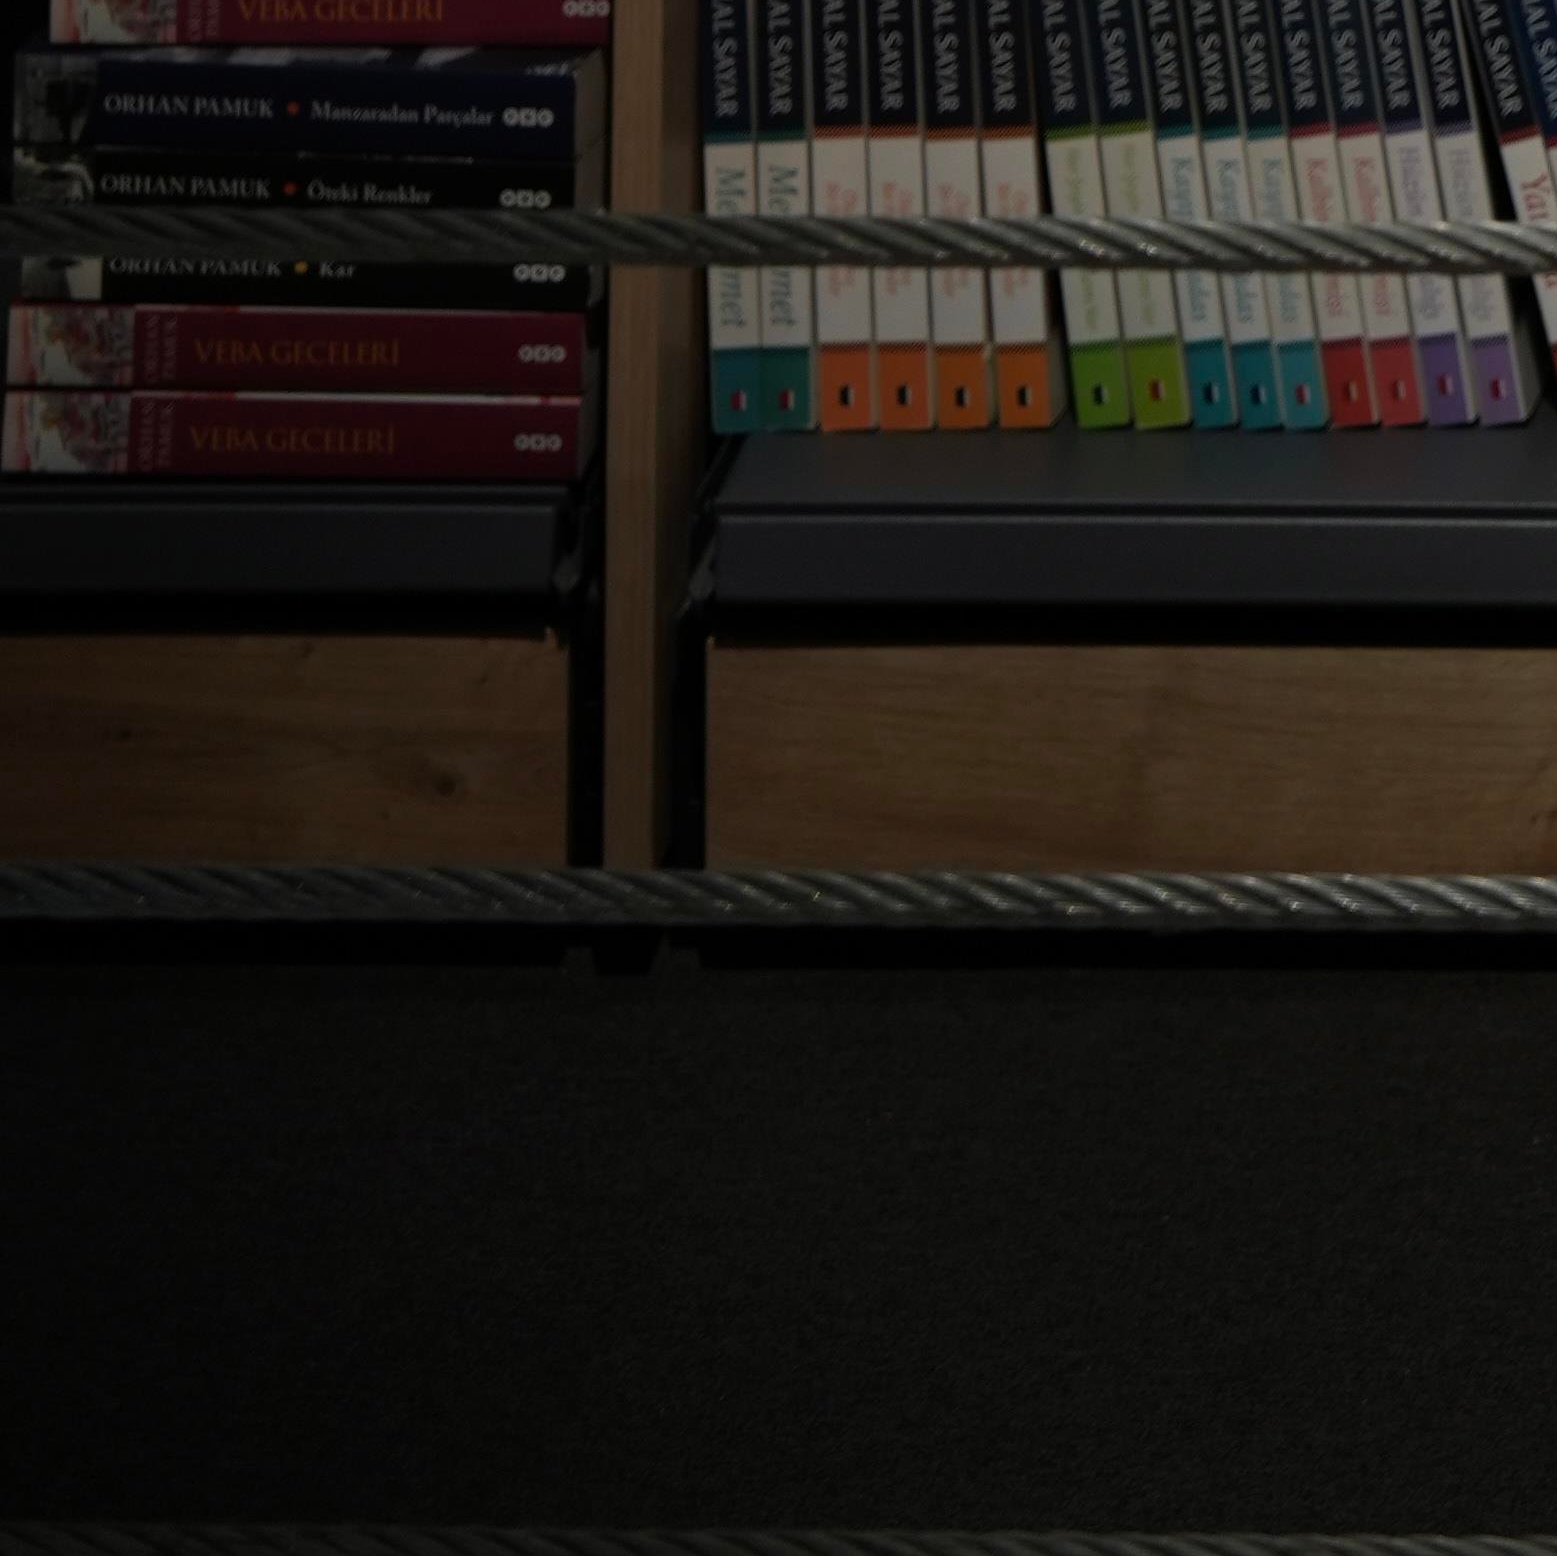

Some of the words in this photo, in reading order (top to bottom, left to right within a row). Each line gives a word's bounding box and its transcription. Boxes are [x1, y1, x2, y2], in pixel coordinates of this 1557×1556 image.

[104, 94, 194, 117] ORHAN
[194, 96, 273, 119] PAMUK
[713, 37, 739, 118] SAYAR
[716, 167, 746, 328] Memet
